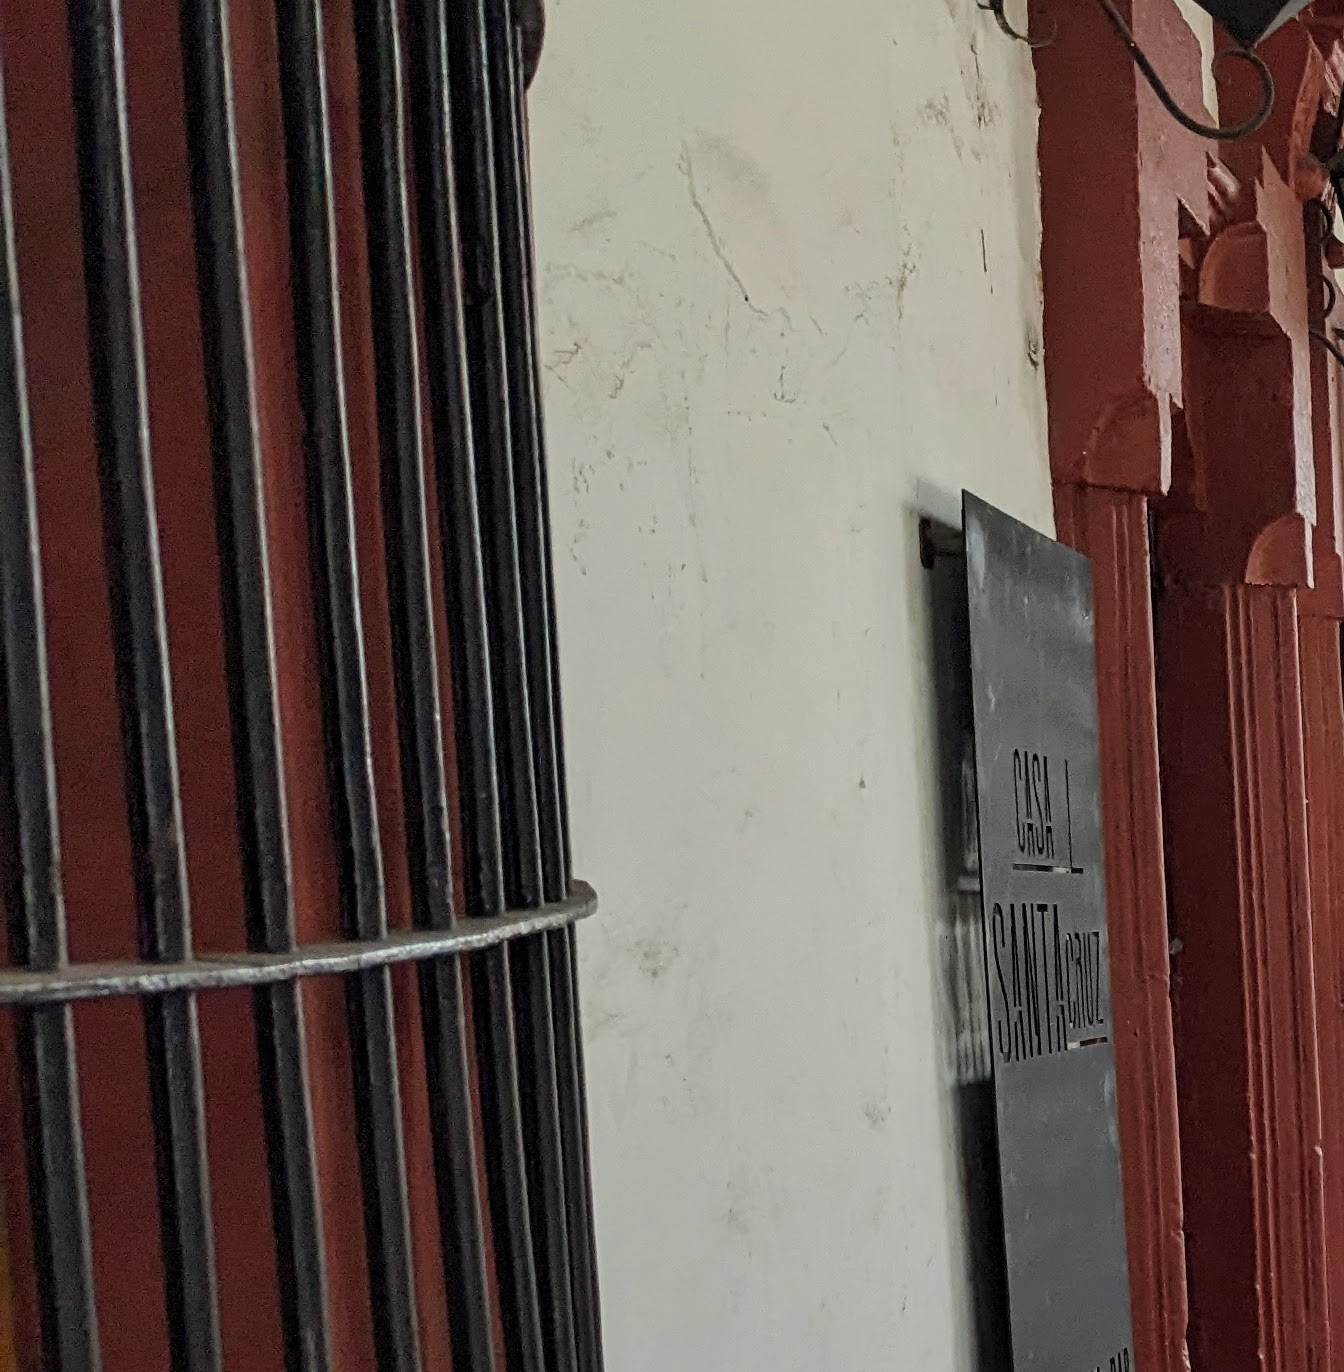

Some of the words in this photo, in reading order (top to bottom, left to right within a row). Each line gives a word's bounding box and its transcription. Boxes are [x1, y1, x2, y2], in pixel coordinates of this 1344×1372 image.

[1013, 748, 1054, 859] CASA
[993, 902, 1068, 1063] SANTA
[1066, 931, 1104, 1029] CRUZ
